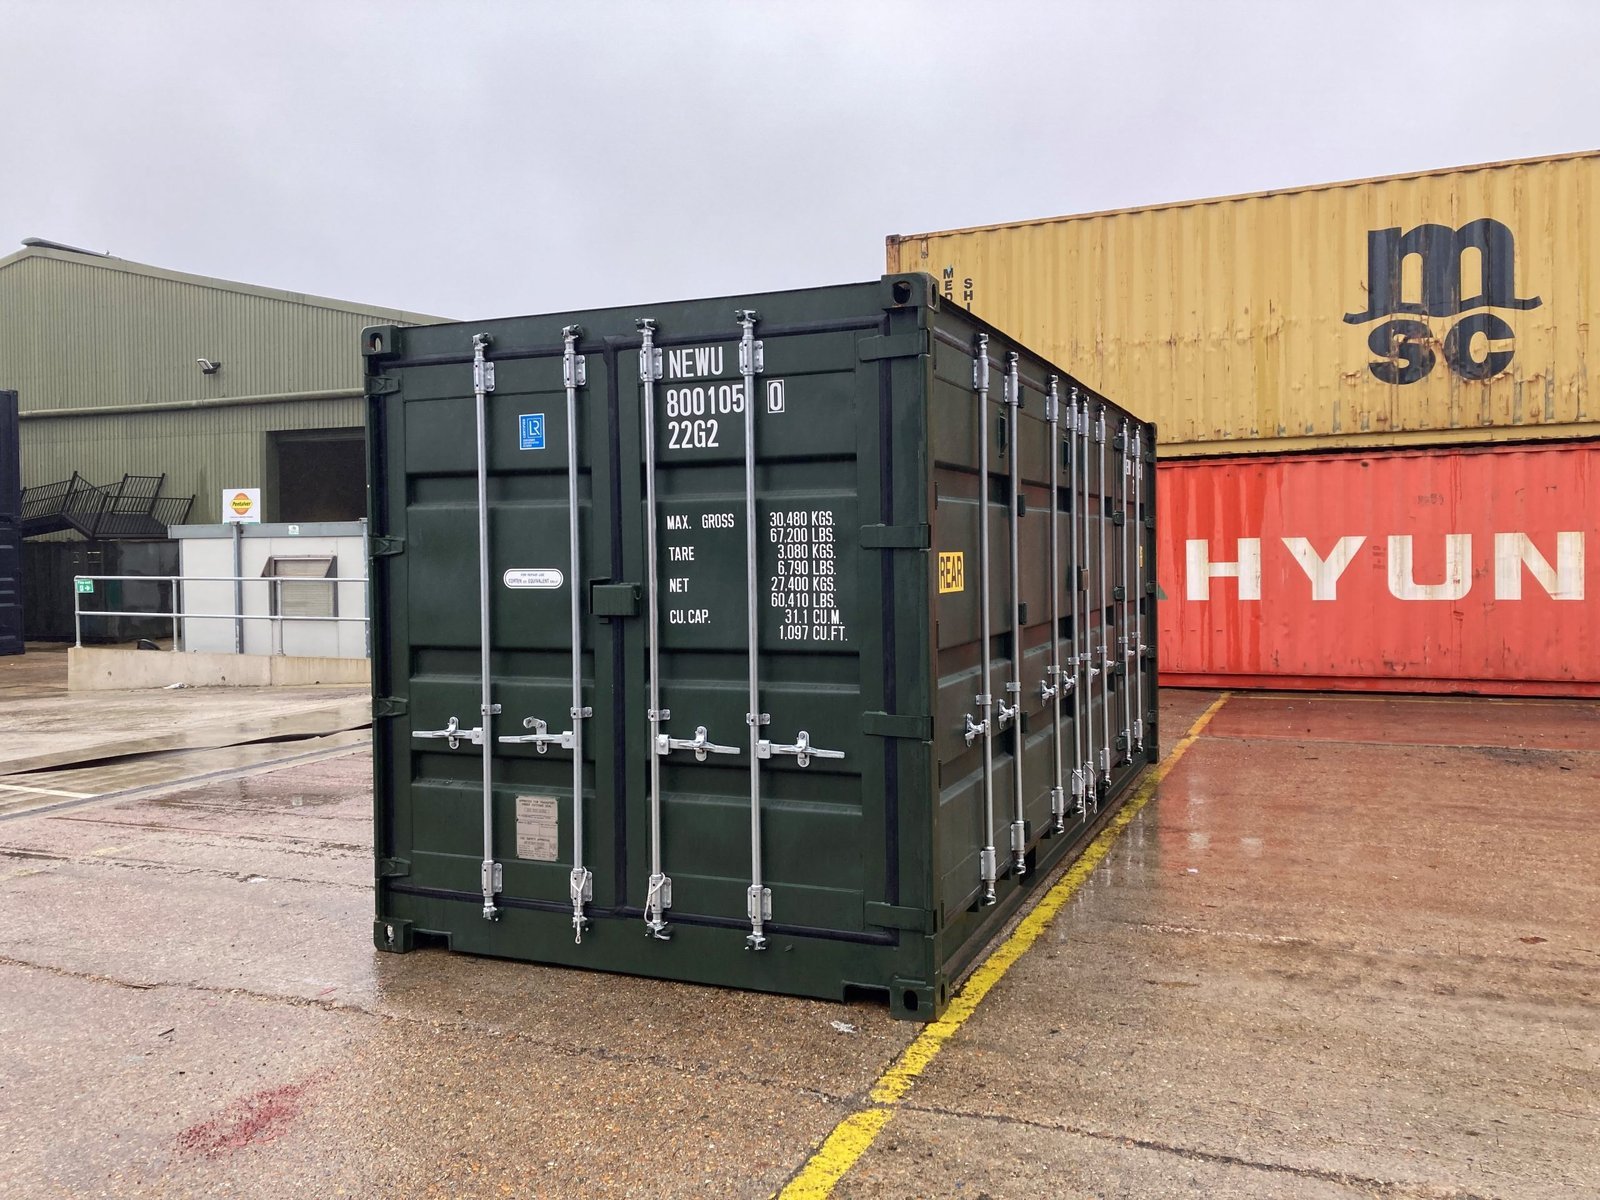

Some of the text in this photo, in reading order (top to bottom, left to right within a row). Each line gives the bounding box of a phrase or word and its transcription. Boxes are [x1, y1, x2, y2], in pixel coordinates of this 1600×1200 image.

[668, 346, 723, 379] NEWU
[666, 384, 745, 417] 800105
[668, 419, 719, 449] 22G2
[666, 515, 692, 530] MAX.
[701, 513, 735, 529] GROSS
[811, 511, 836, 526] KGS.
[770, 527, 836, 543] 67,200 LBS.
[668, 546, 695, 561] TARE
[812, 543, 837, 559] KGS.
[812, 560, 837, 575] LBS.
[940, 555, 963, 589] REAR
[1186, 531, 1585, 600] HYUN
[669, 578, 689, 593] NET
[812, 576, 837, 591] KGS.
[812, 592, 837, 608] LBS.
[784, 609, 808, 624] 31.1
